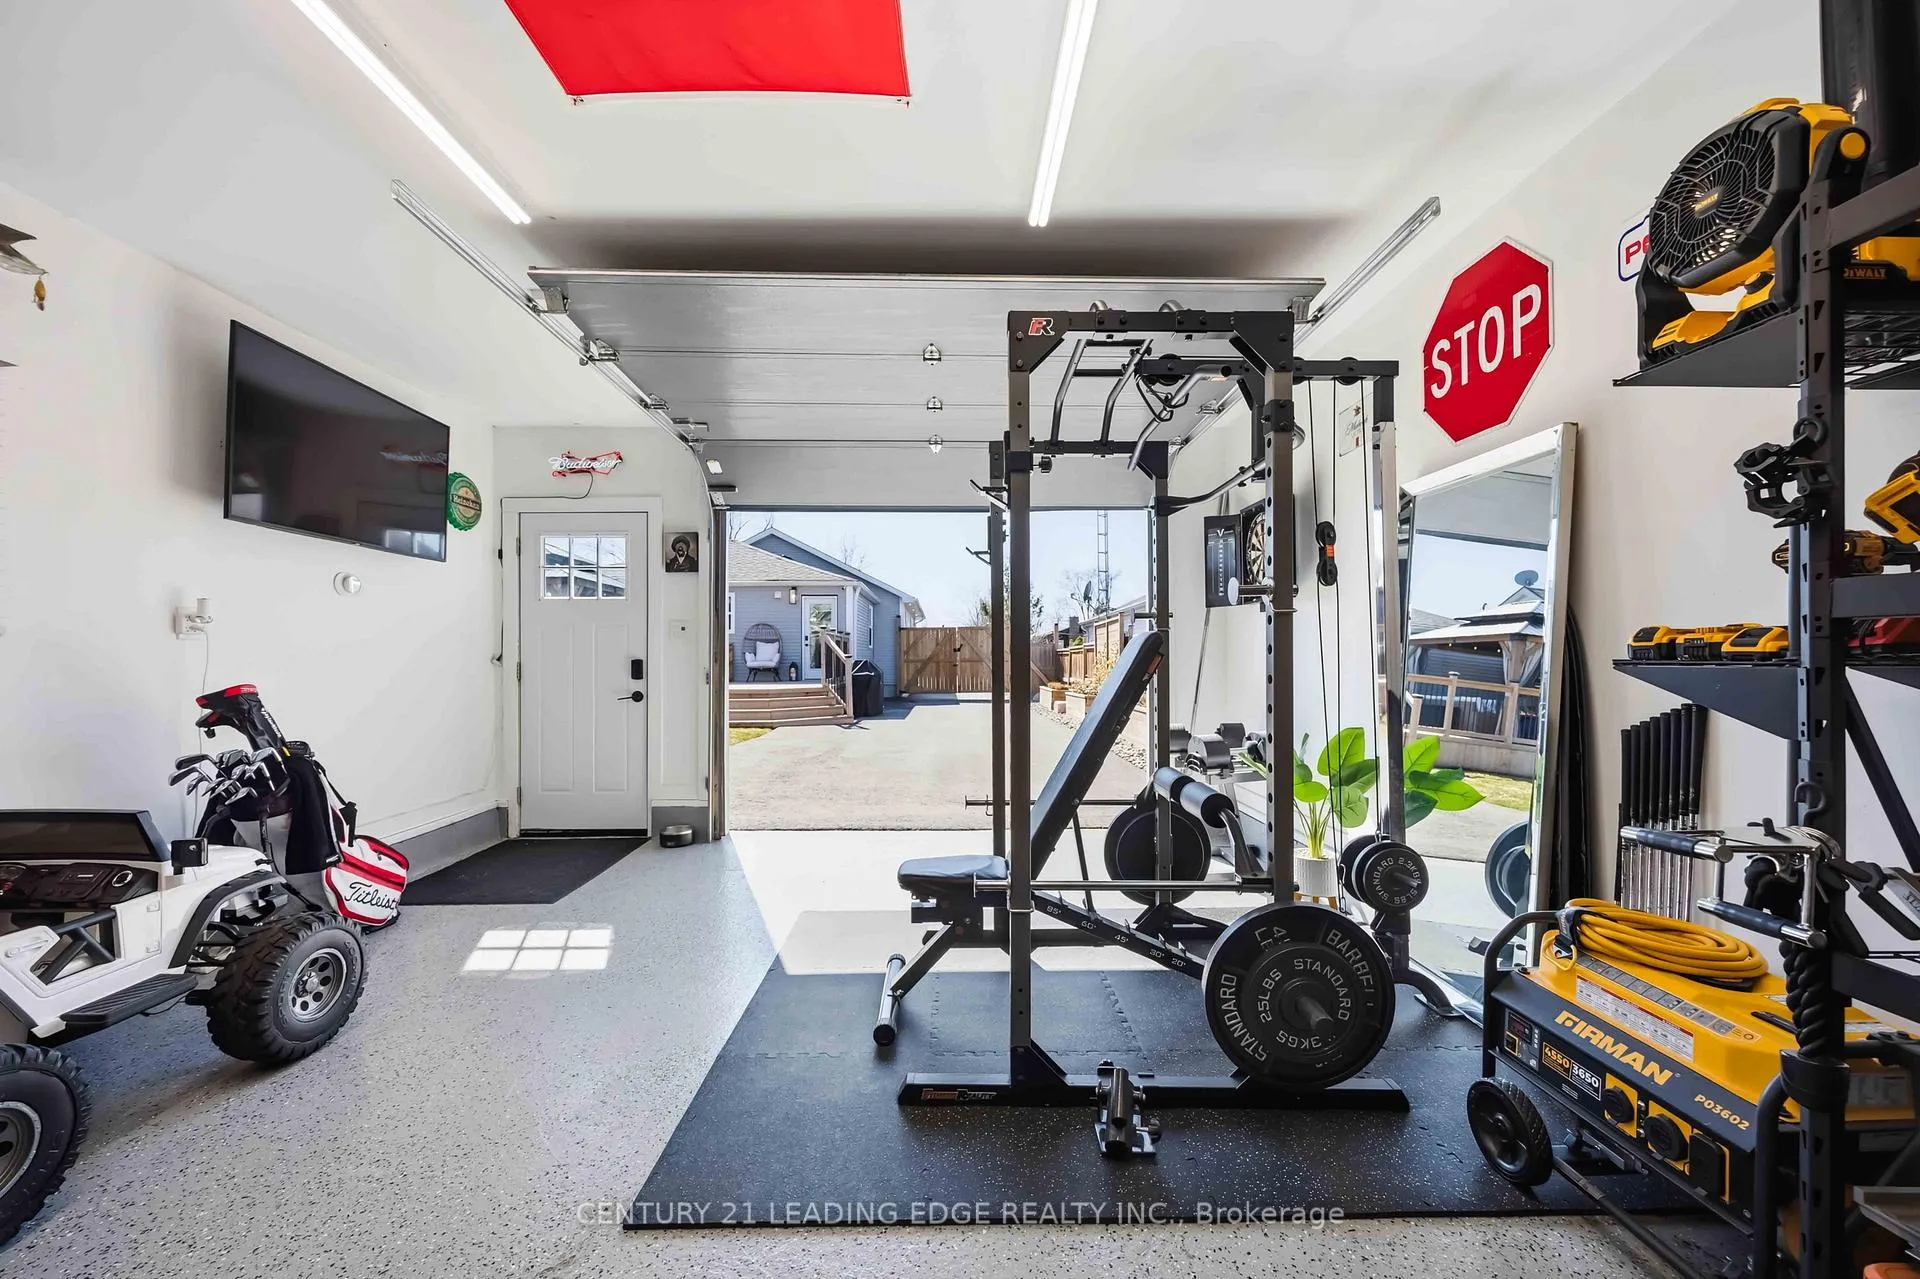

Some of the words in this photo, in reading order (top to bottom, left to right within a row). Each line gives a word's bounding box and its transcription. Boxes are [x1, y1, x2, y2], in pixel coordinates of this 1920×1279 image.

[1430, 283, 1542, 399] STOP
[344, 881, 398, 910] Titleist
[1220, 973, 1268, 1062] STANDARD
[1257, 968, 1283, 1024] 25LBS
[1294, 958, 1351, 1021] STANDARD
[1544, 1046, 1570, 1069] 4550
[1555, 1009, 1674, 1086] FIRMAN
[1572, 1063, 1599, 1088] 3650
